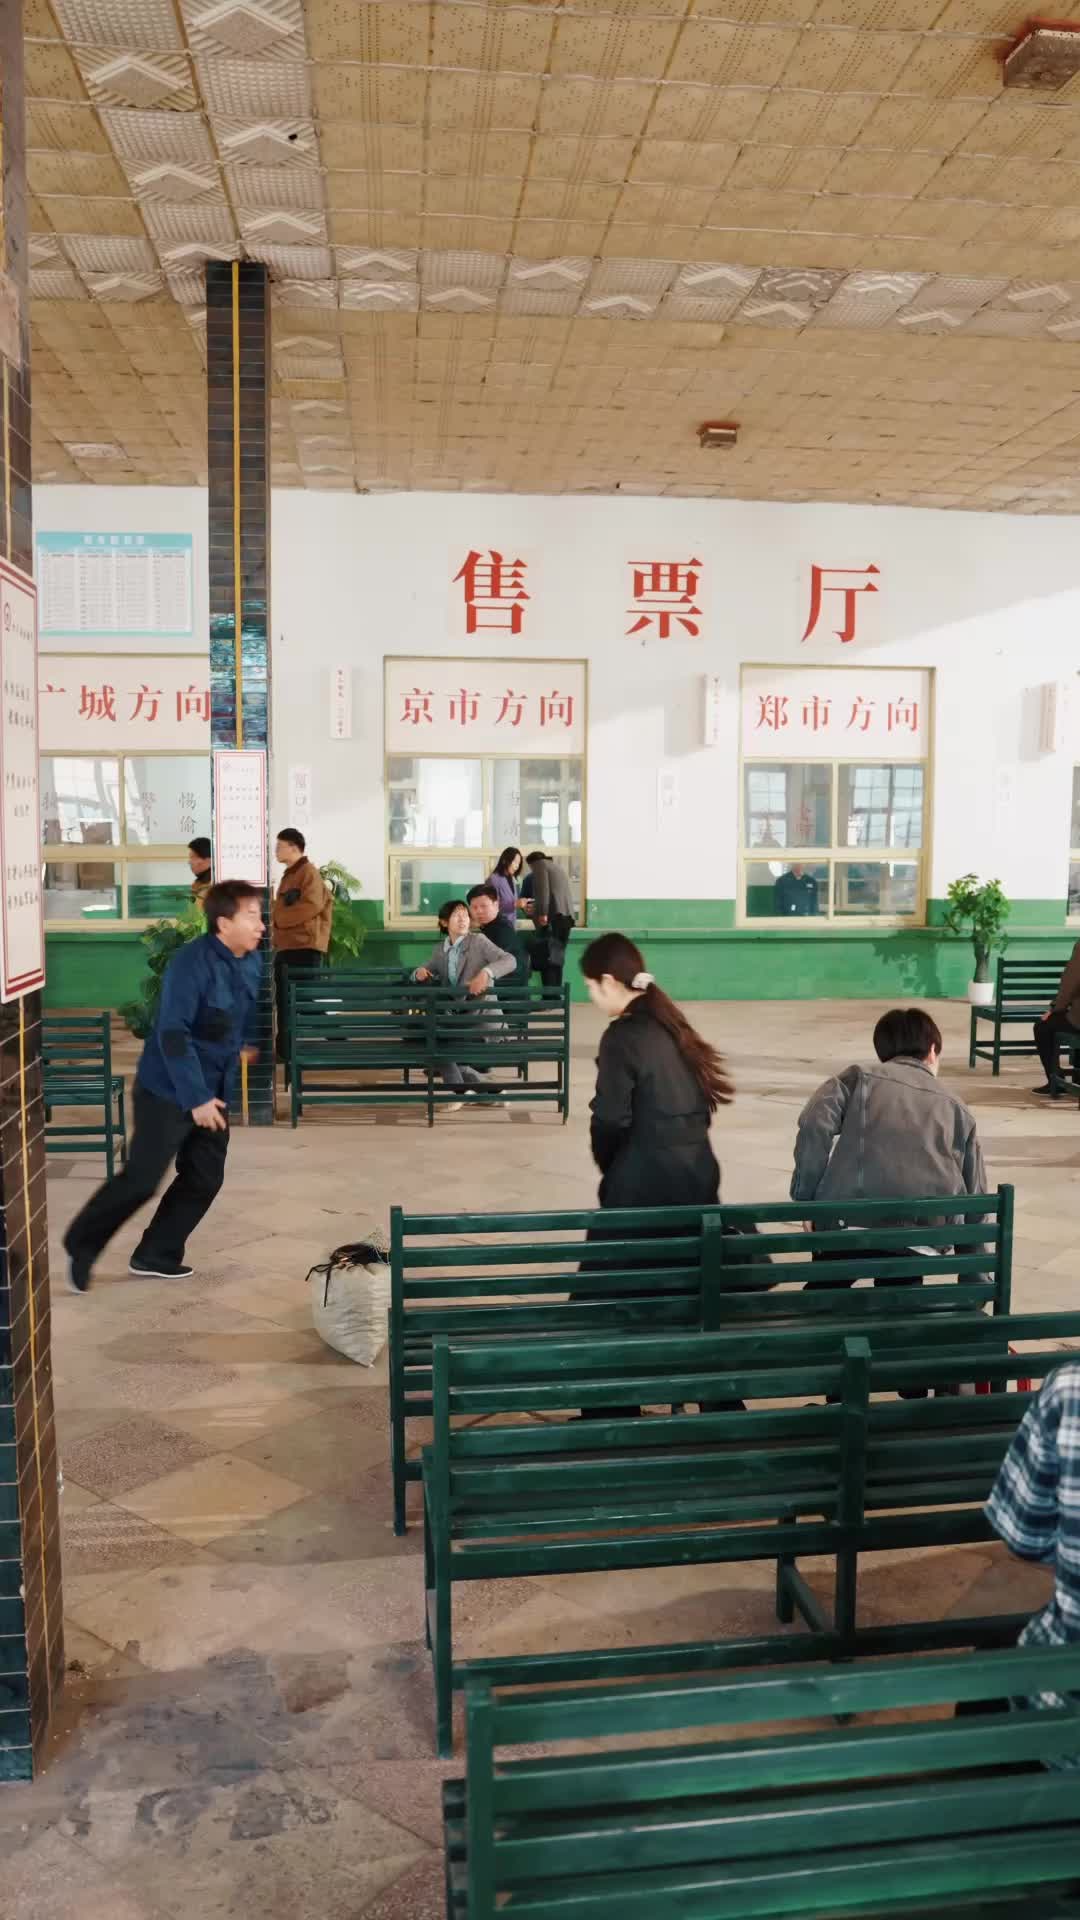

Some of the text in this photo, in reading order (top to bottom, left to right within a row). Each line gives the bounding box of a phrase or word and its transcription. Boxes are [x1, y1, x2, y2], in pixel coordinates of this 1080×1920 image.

[452, 550, 881, 643] 售票厅
[400, 688, 575, 727] 京市方向
[755, 695, 919, 732] 郑市方向
